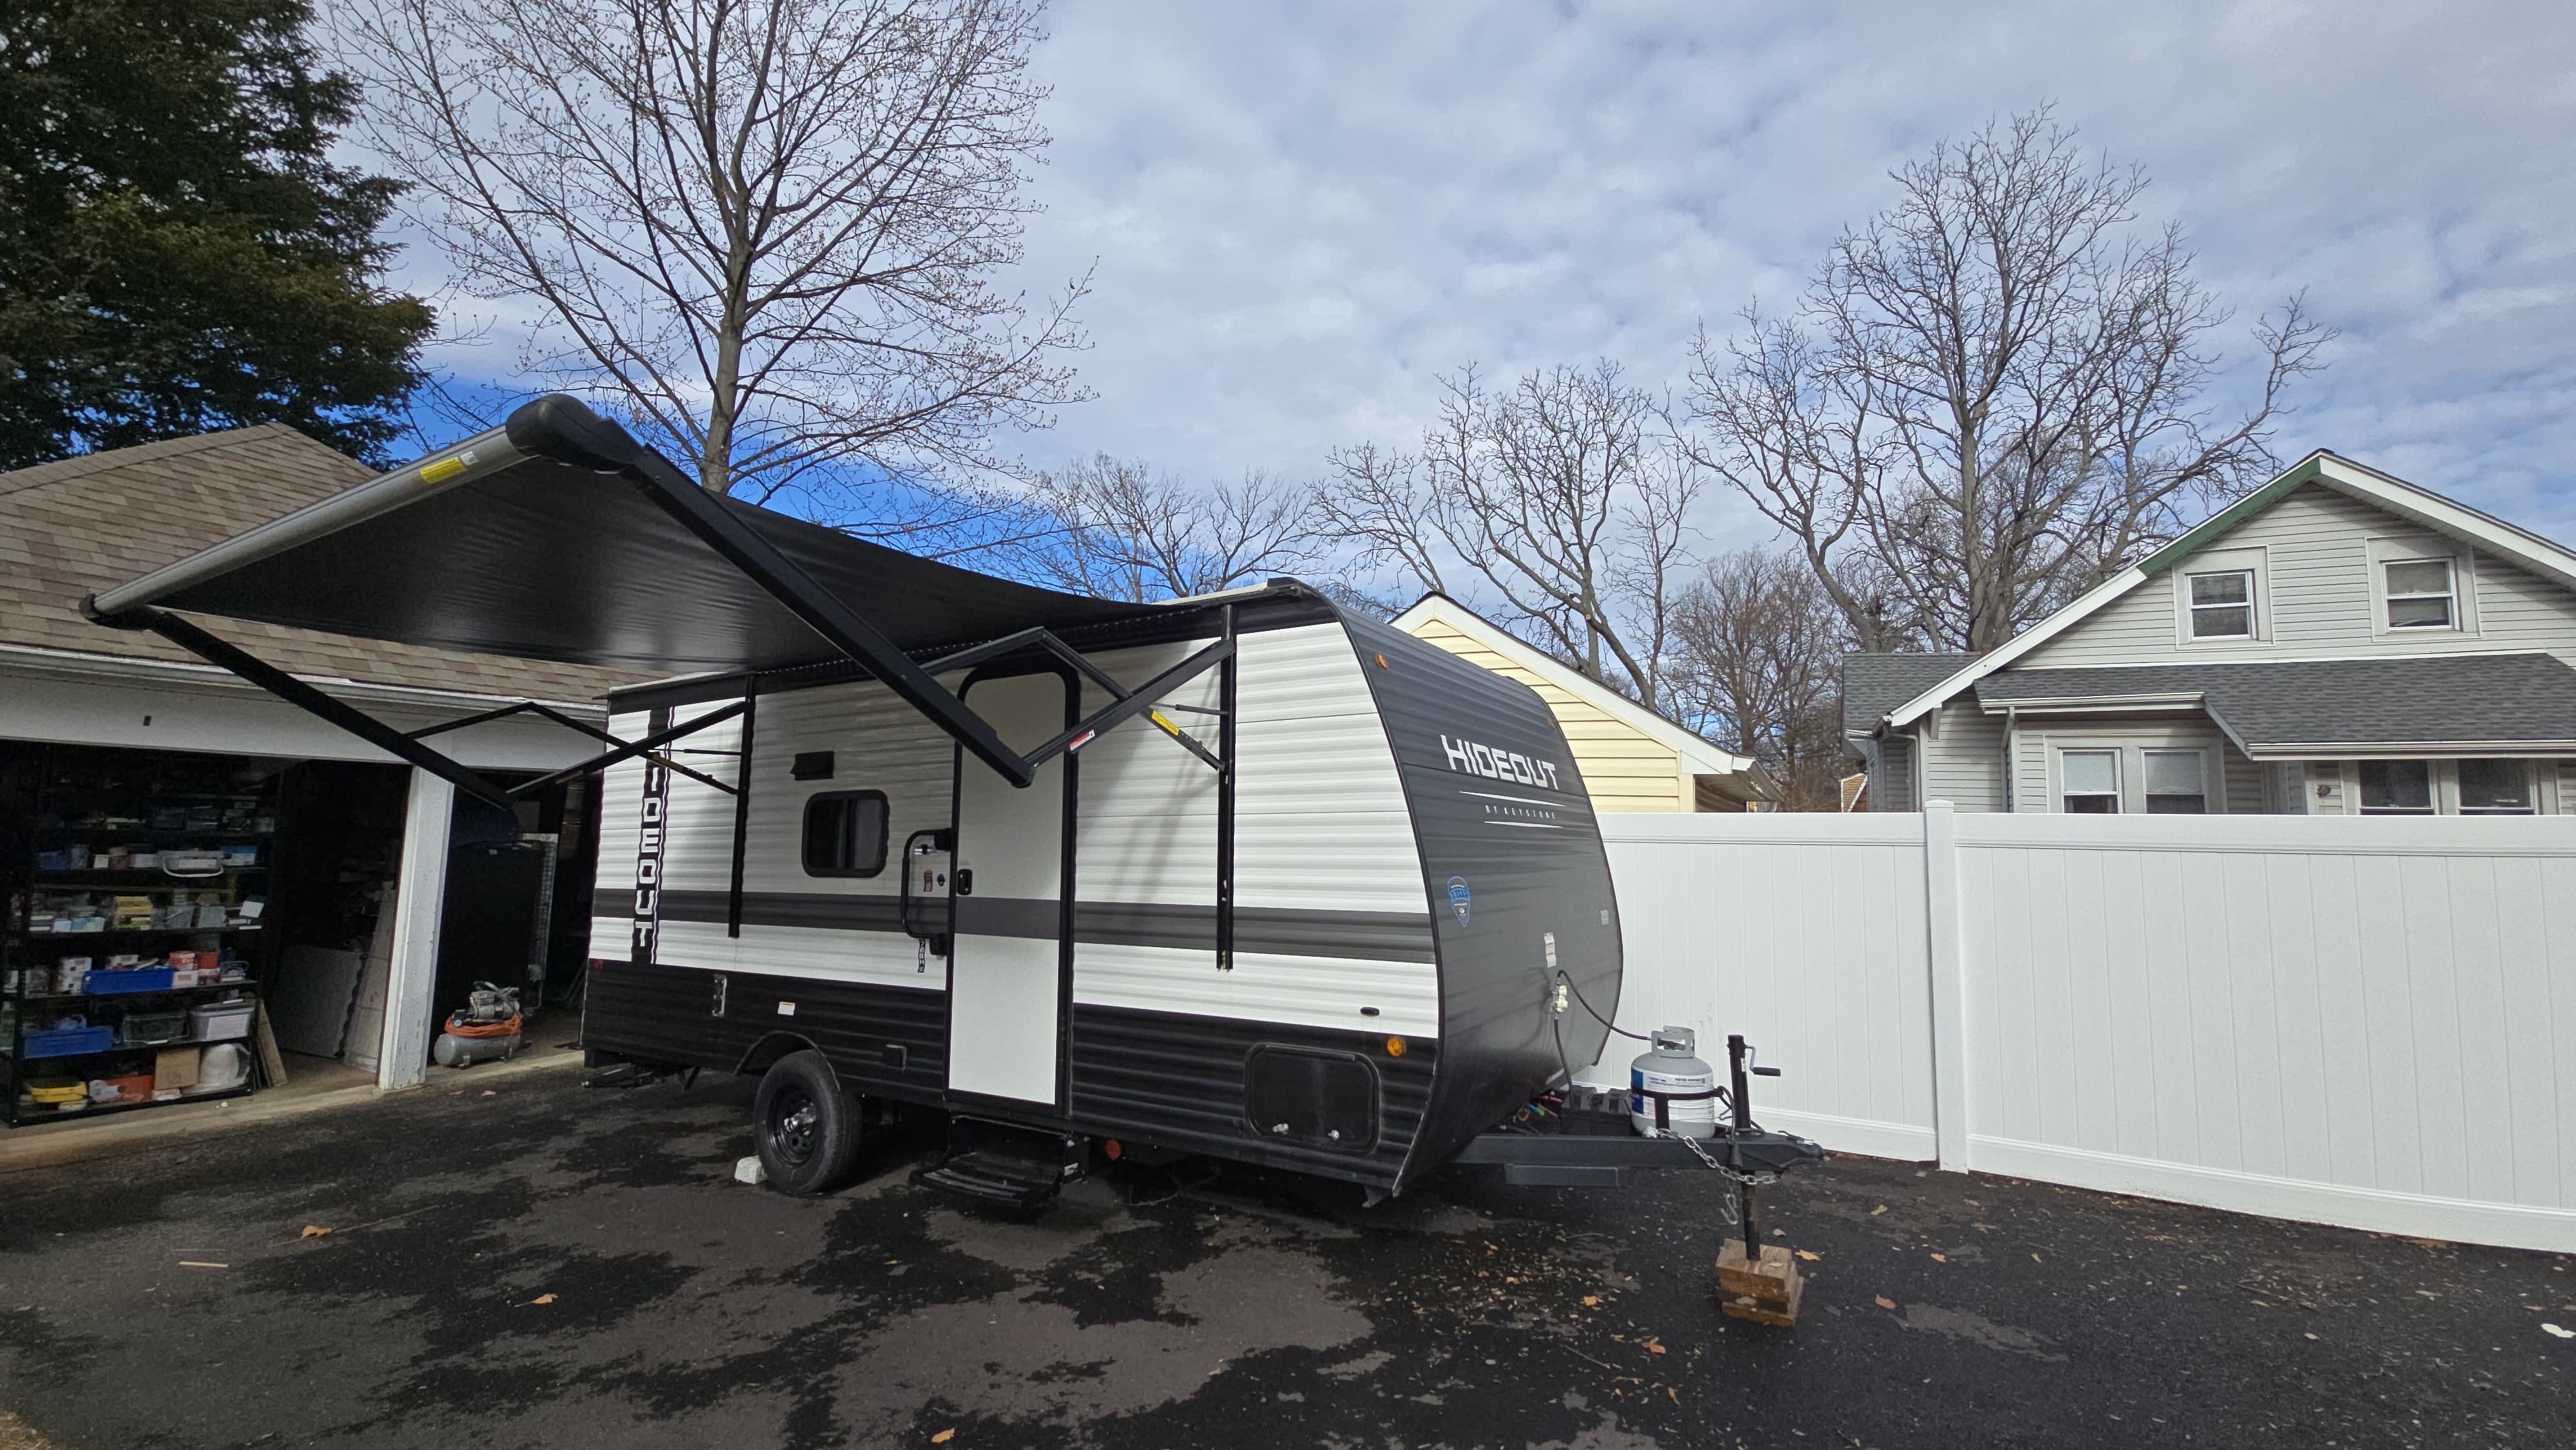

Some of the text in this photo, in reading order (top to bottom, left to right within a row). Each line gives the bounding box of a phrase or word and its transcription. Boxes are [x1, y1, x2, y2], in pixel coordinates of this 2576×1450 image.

[1440, 734, 1559, 790] HIDEOUT
[1485, 804, 1556, 820] BY KEYSTONE
